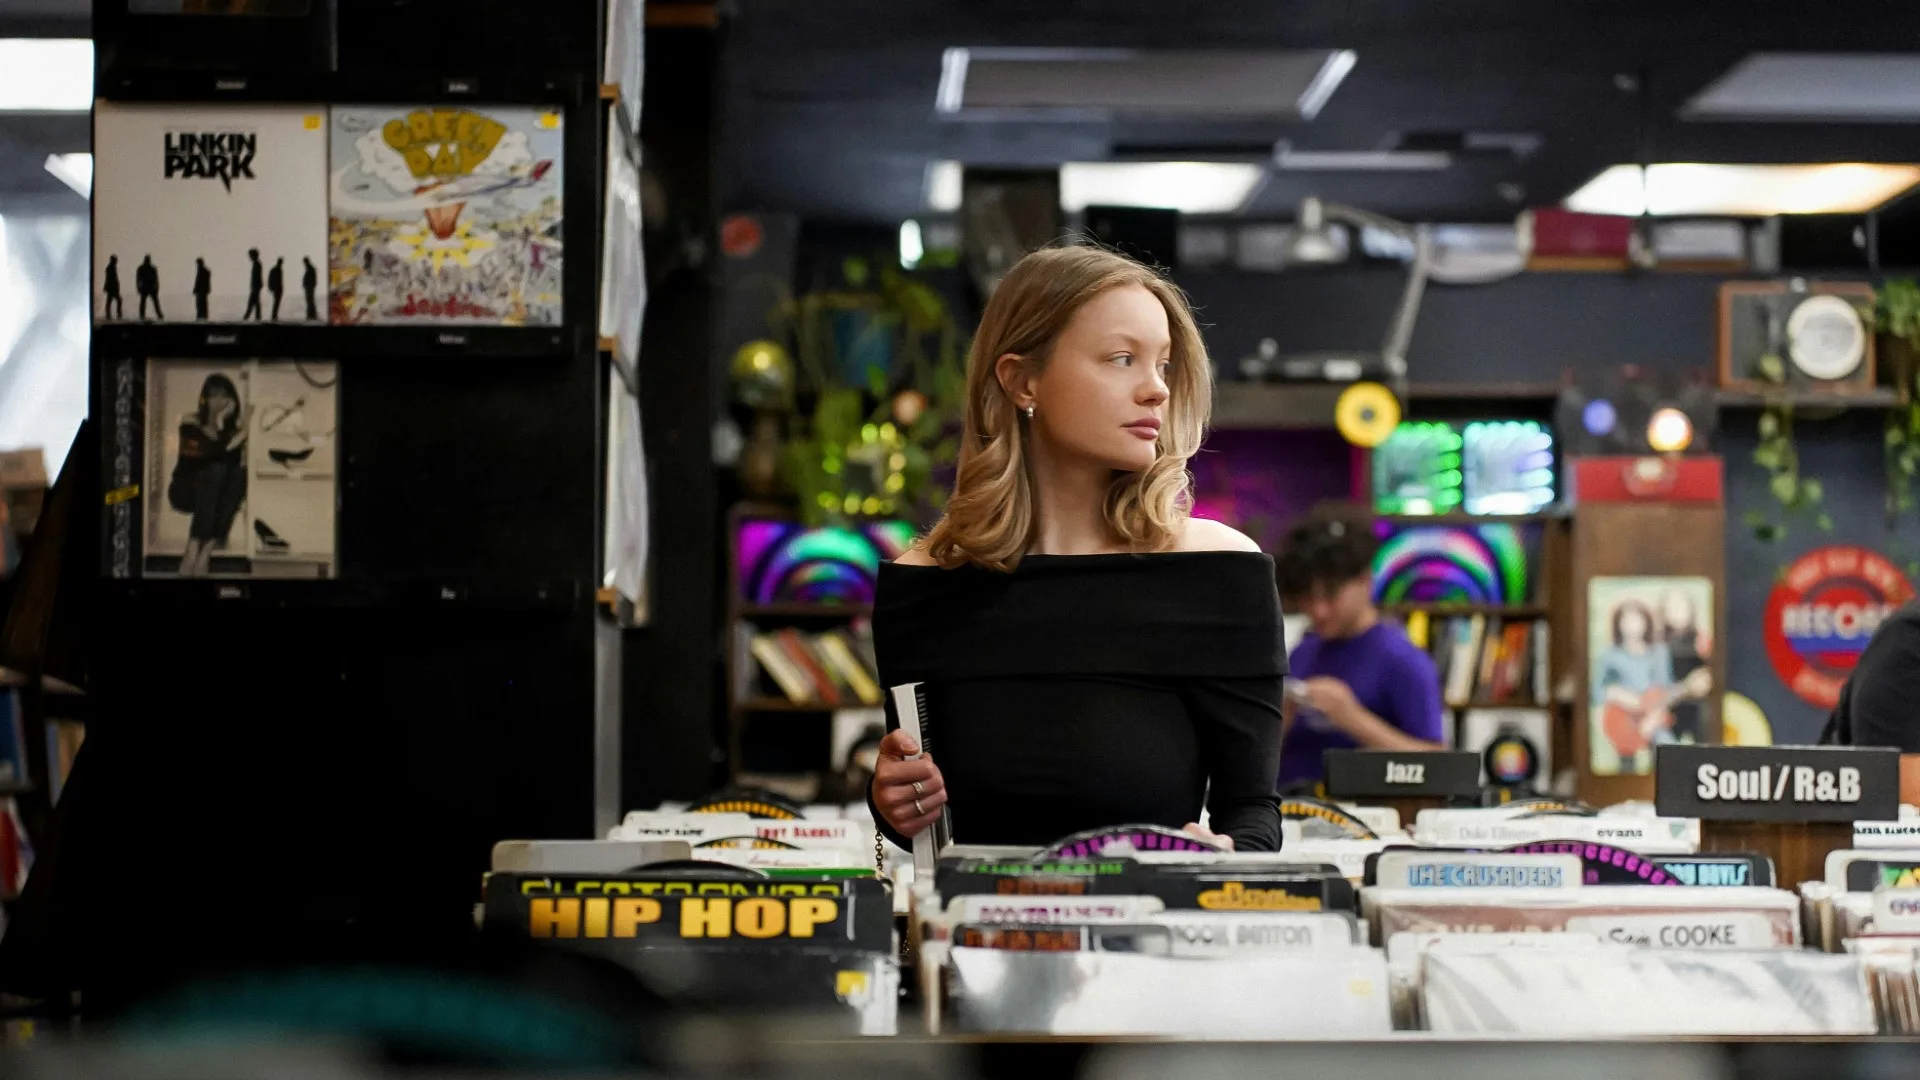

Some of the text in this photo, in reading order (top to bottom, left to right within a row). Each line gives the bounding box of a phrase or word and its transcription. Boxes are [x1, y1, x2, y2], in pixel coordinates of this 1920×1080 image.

[164, 132, 257, 154] LINKIN
[382, 107, 508, 150] GREEN
[164, 153, 257, 193] PARK
[404, 140, 491, 178] DAY
[1385, 761, 1425, 783] Jazz
[1448, 866, 1564, 887] CRUSADERS
[530, 898, 838, 938] HIP HOP
[1659, 924, 1736, 947] COOKE
